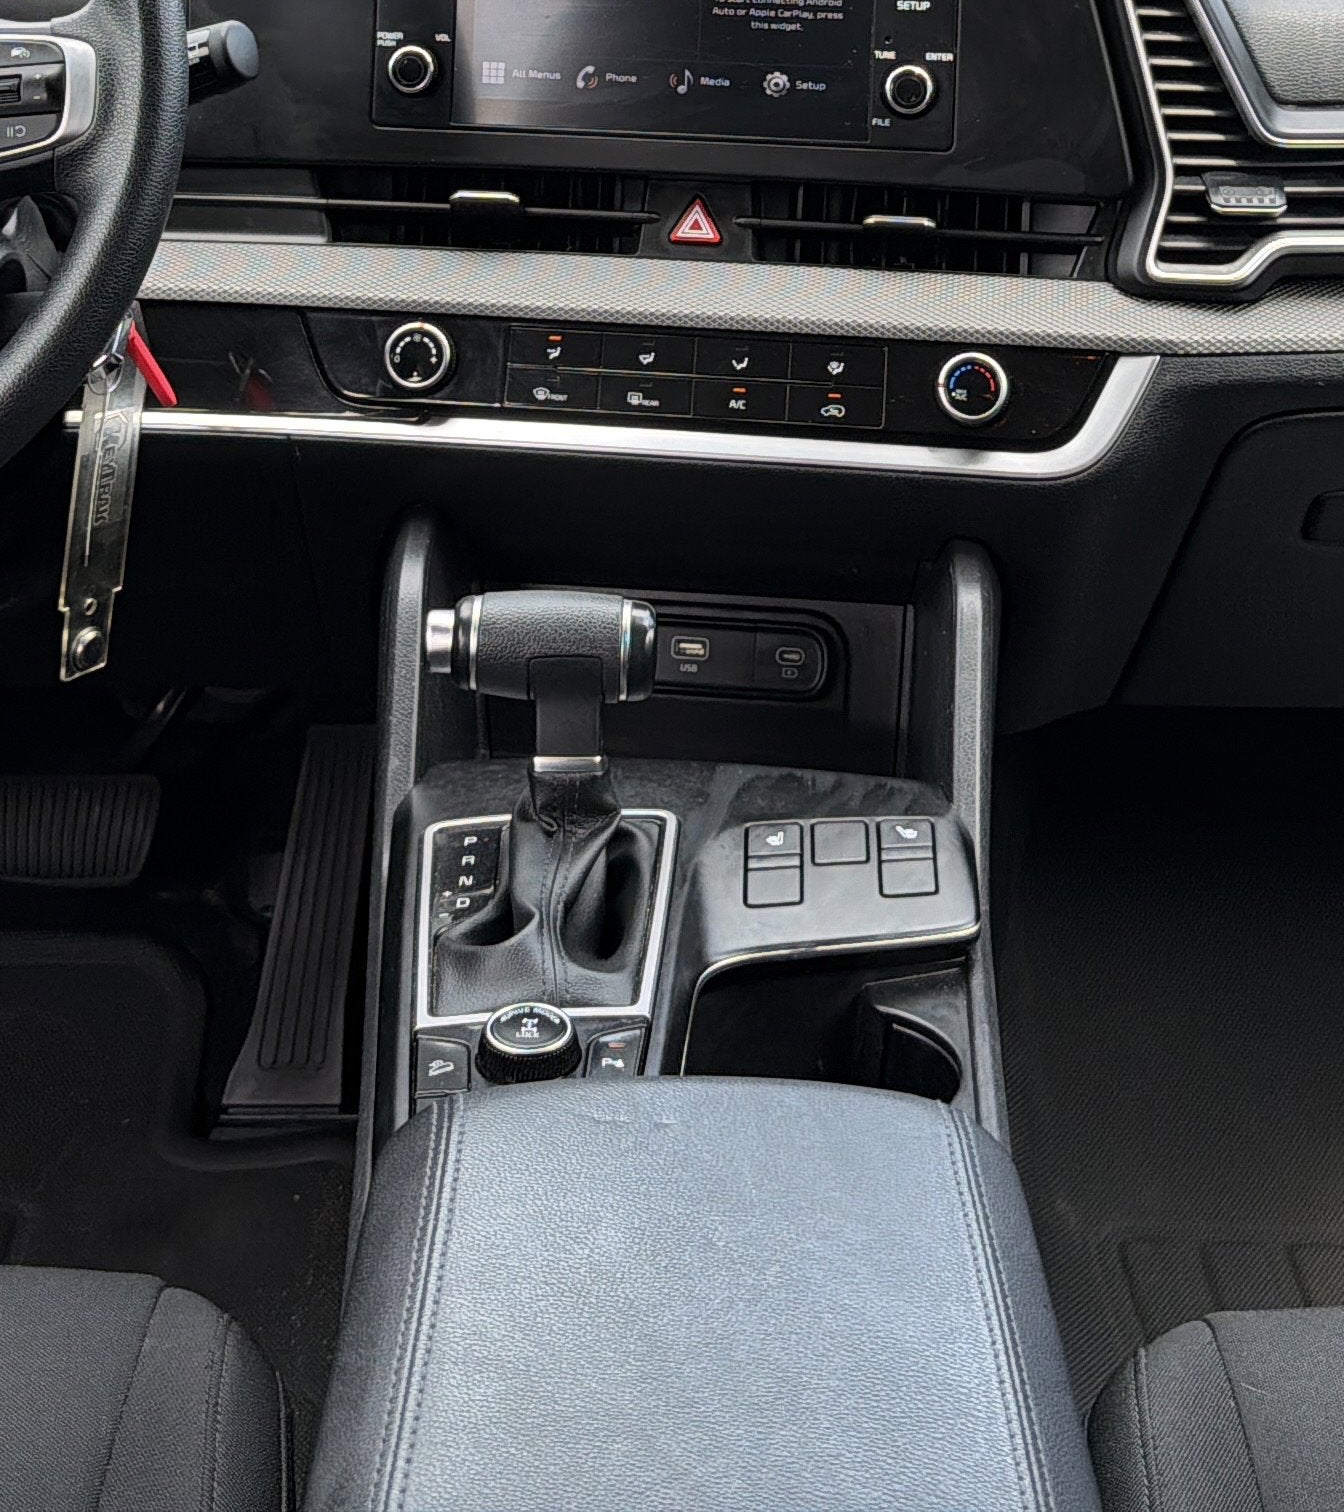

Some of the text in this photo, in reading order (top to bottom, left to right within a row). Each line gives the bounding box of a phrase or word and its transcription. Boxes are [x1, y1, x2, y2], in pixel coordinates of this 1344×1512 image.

[897, 0, 931, 11] SETUP
[712, 7, 735, 16] Auto
[749, 8, 776, 18] Apple
[817, 11, 844, 20] press
[751, 21, 769, 29] this
[377, 31, 404, 40] POWER
[435, 33, 451, 42] VOL
[874, 50, 896, 60] TUNE
[925, 53, 954, 61] ENTER
[512, 68, 561, 80] All Menus
[606, 73, 637, 83] Phone
[700, 77, 730, 87] Media
[795, 81, 826, 91] Setup
[872, 118, 891, 127] FILE
[729, 399, 747, 410] A/C
[679, 664, 698, 673] USB
[464, 836, 478, 847] P
[461, 855, 475, 867] R
[458, 875, 473, 887] N
[456, 897, 470, 908] D
